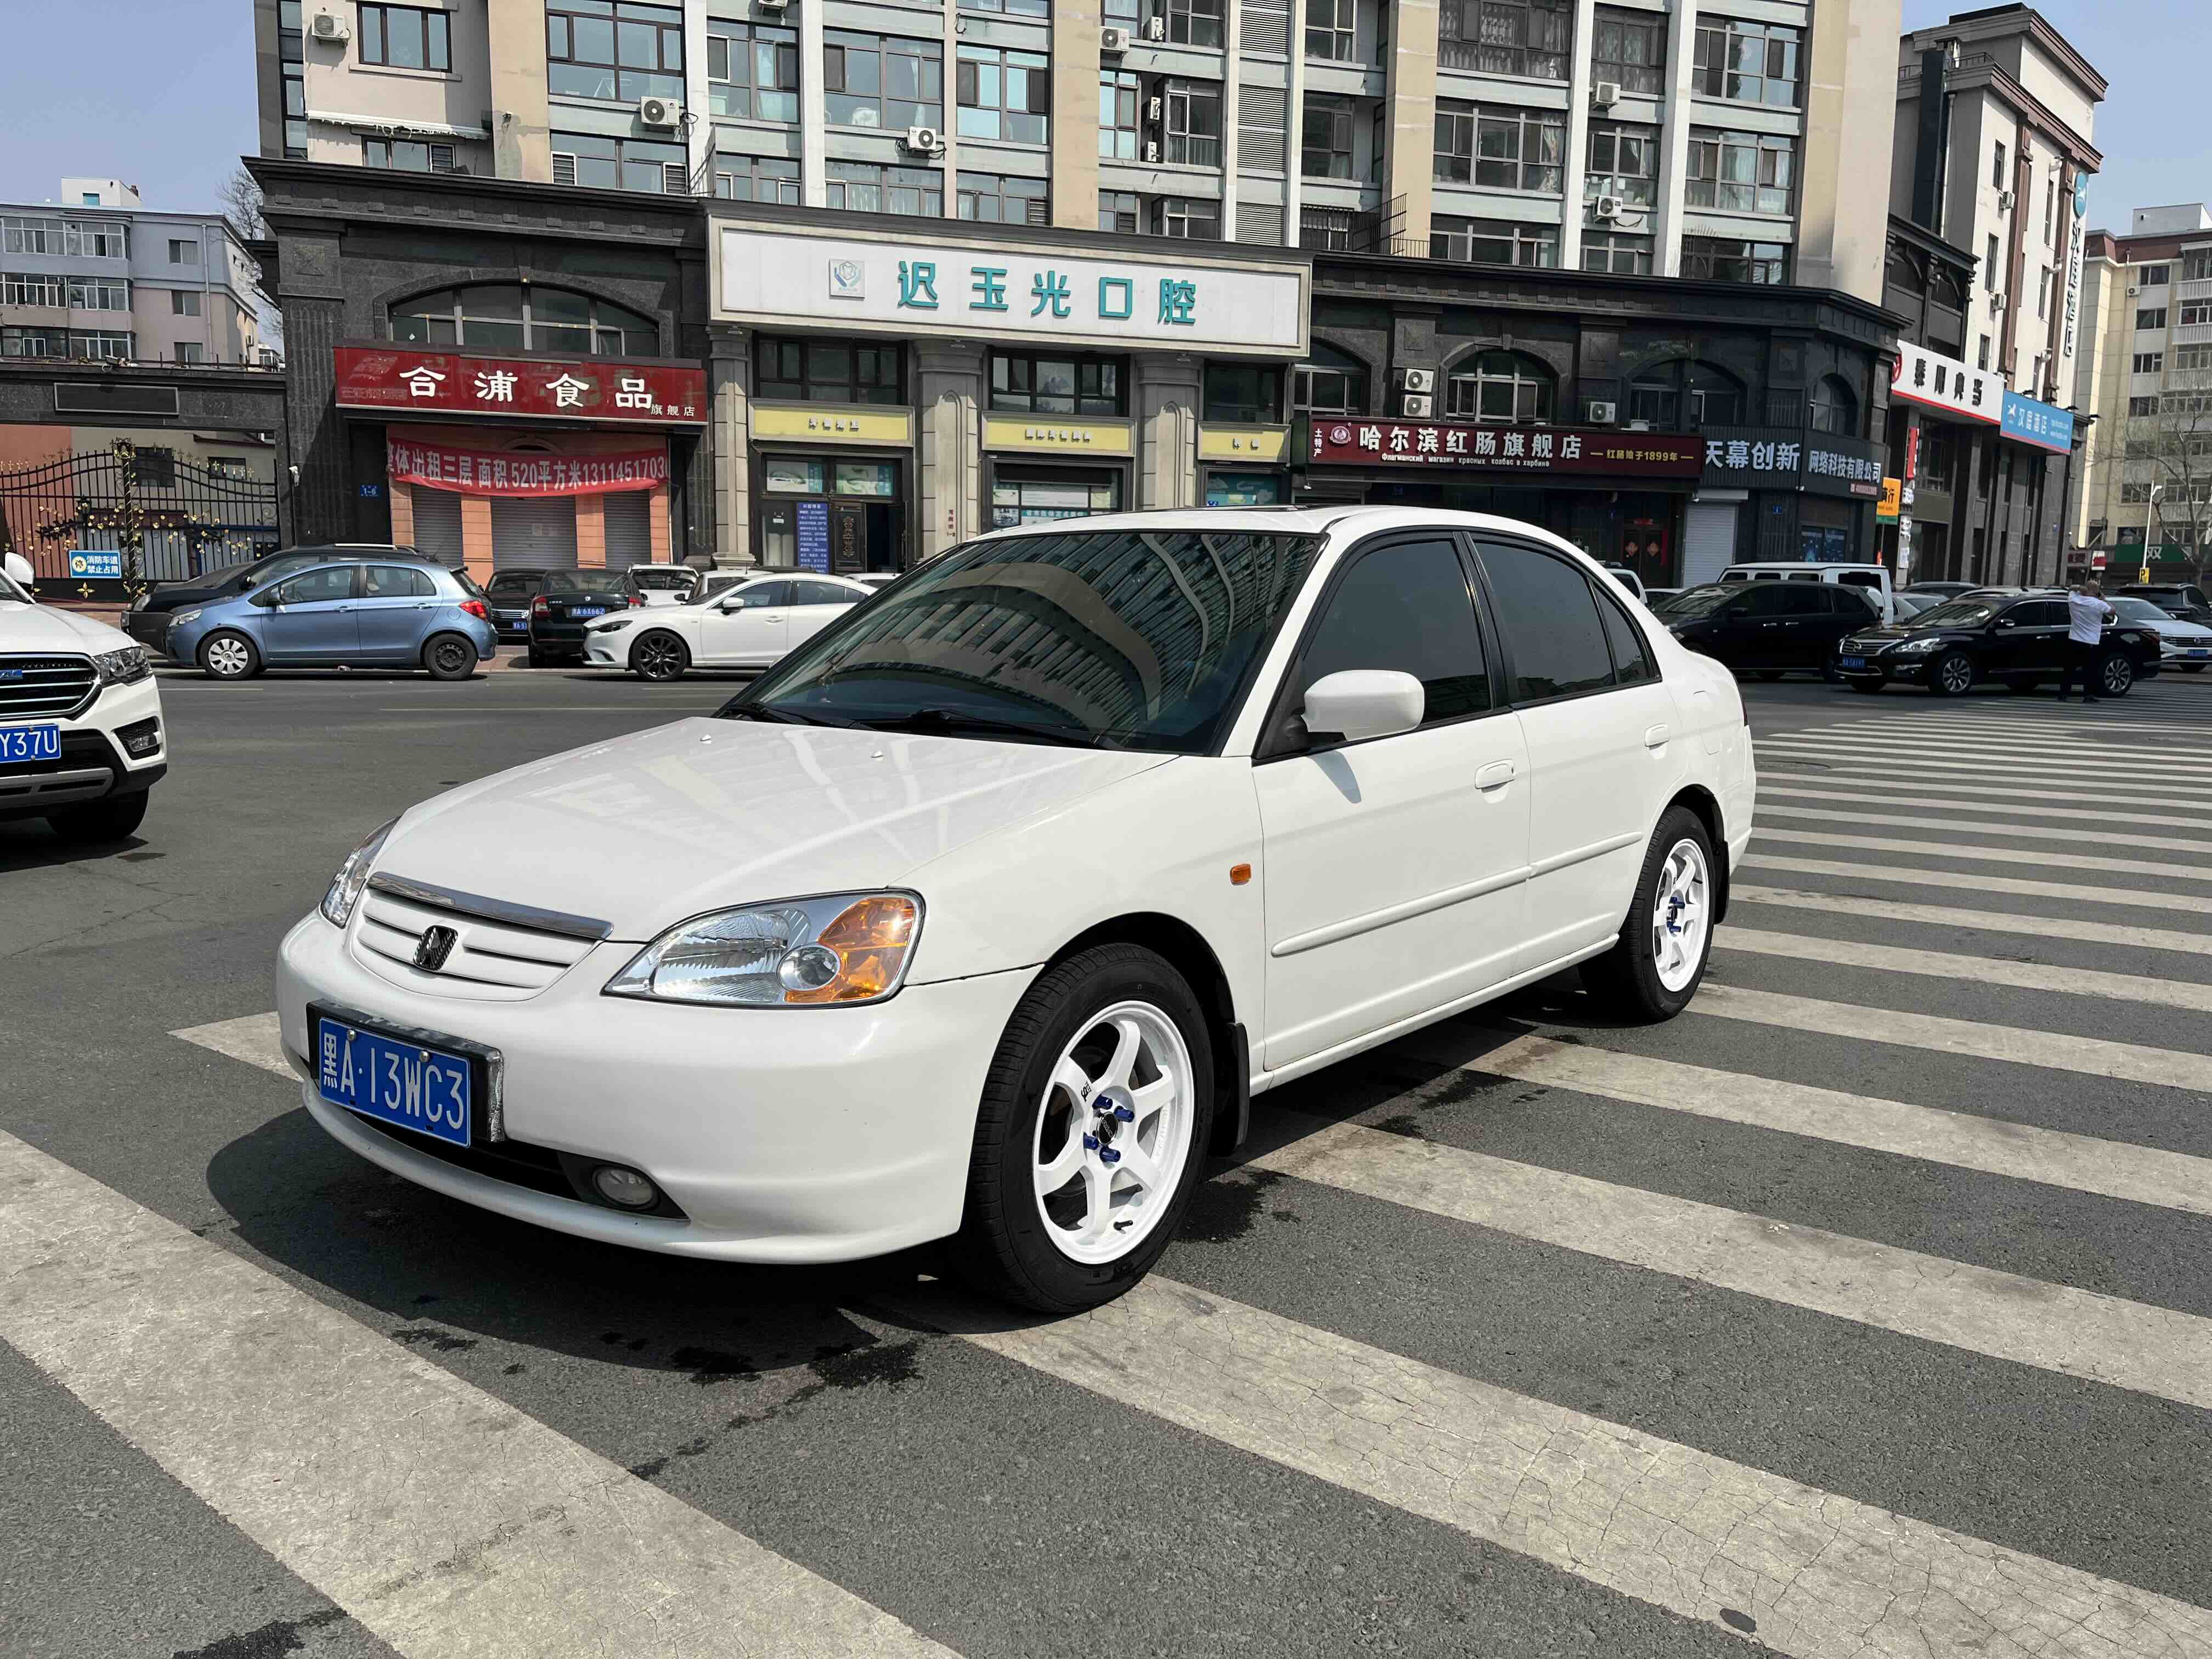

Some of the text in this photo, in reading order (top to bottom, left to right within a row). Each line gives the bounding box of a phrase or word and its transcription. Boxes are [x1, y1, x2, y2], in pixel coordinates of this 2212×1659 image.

[898, 261, 1196, 325] 迟玉光口腔
[399, 366, 652, 409] 合浦食品
[651, 404, 695, 417] 旗舰店
[1313, 428, 1323, 457] 土特产
[1359, 425, 1582, 460] 哈尔滨红肠旗舰店
[1705, 440, 1801, 471] 天幕创新
[1808, 450, 1882, 483] 网络科技有限公司
[87, 555, 119, 565] 消防车道
[87, 565, 119, 574] 禁止占用
[0, 730, 58, 758] Y37U
